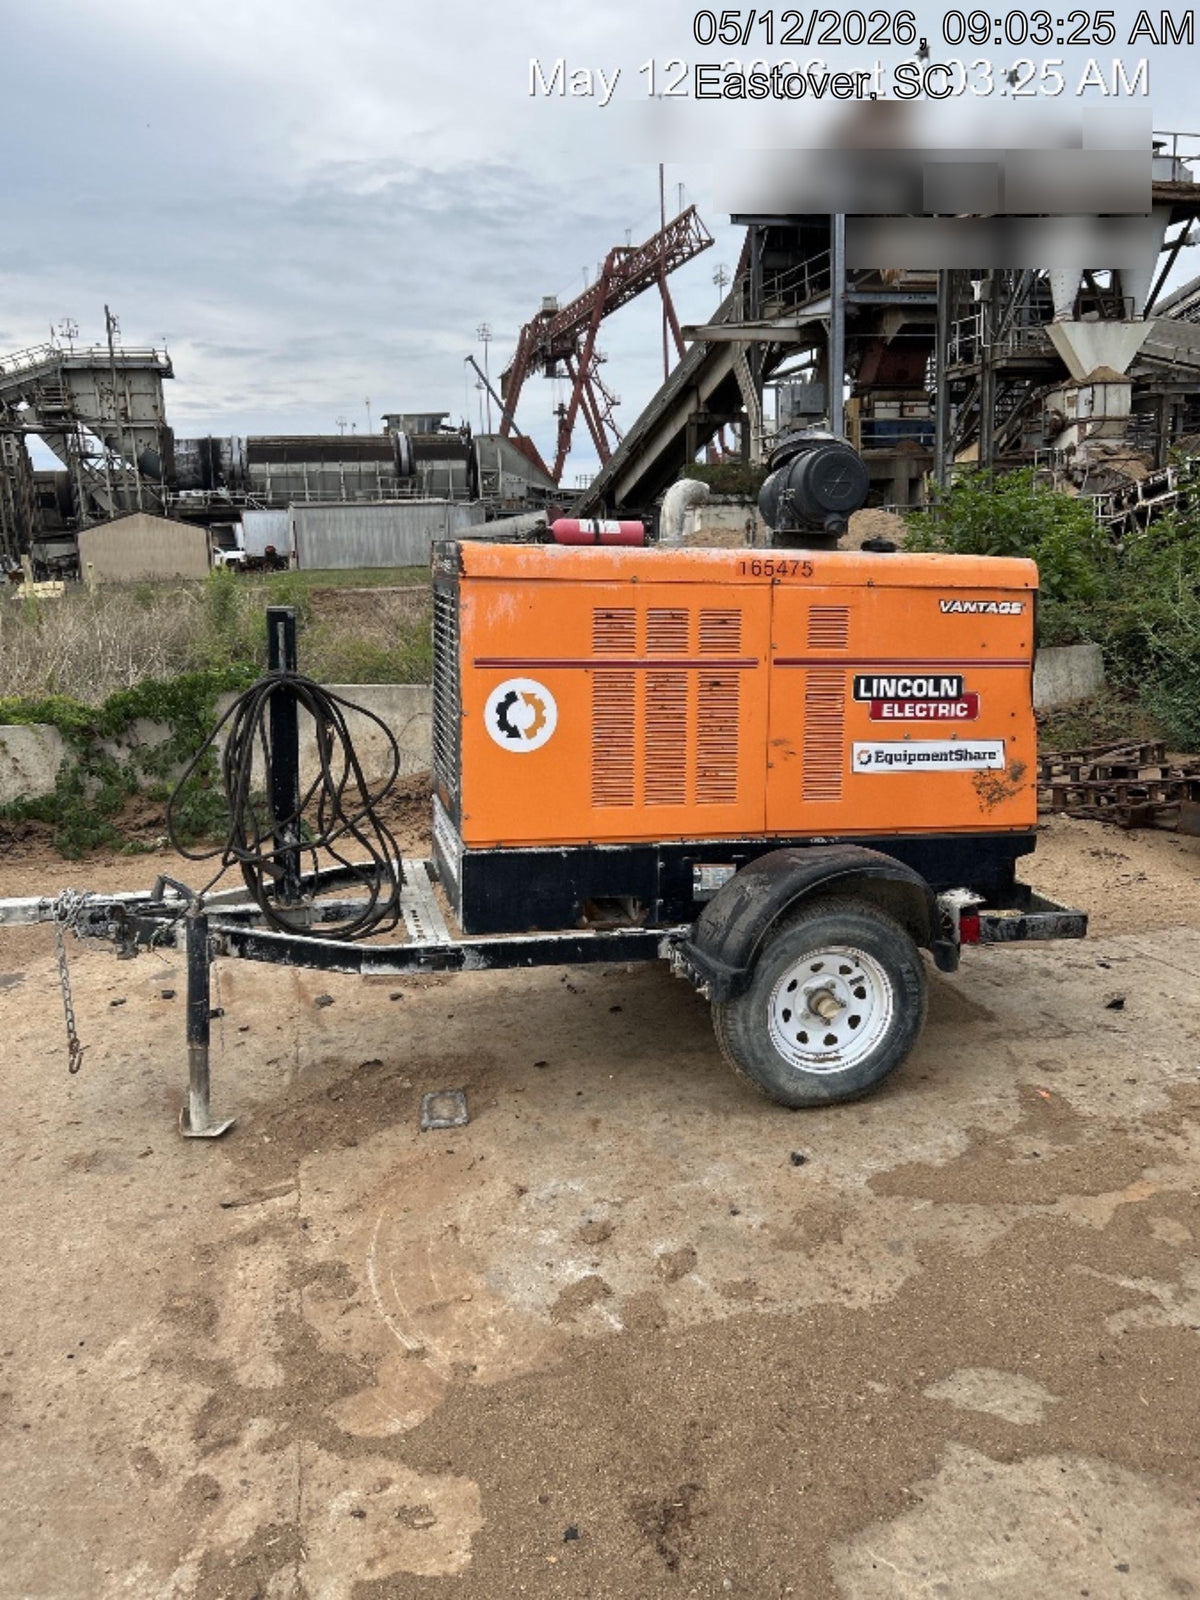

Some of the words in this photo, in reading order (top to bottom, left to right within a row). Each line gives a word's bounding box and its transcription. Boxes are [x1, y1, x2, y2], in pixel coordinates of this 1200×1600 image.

[739, 559, 814, 578] 165475
[939, 599, 1024, 615] VANTAGE
[859, 677, 958, 698] LINCOLN
[881, 702, 969, 718] ELECTRIC
[874, 748, 997, 765] EquipmentShare
